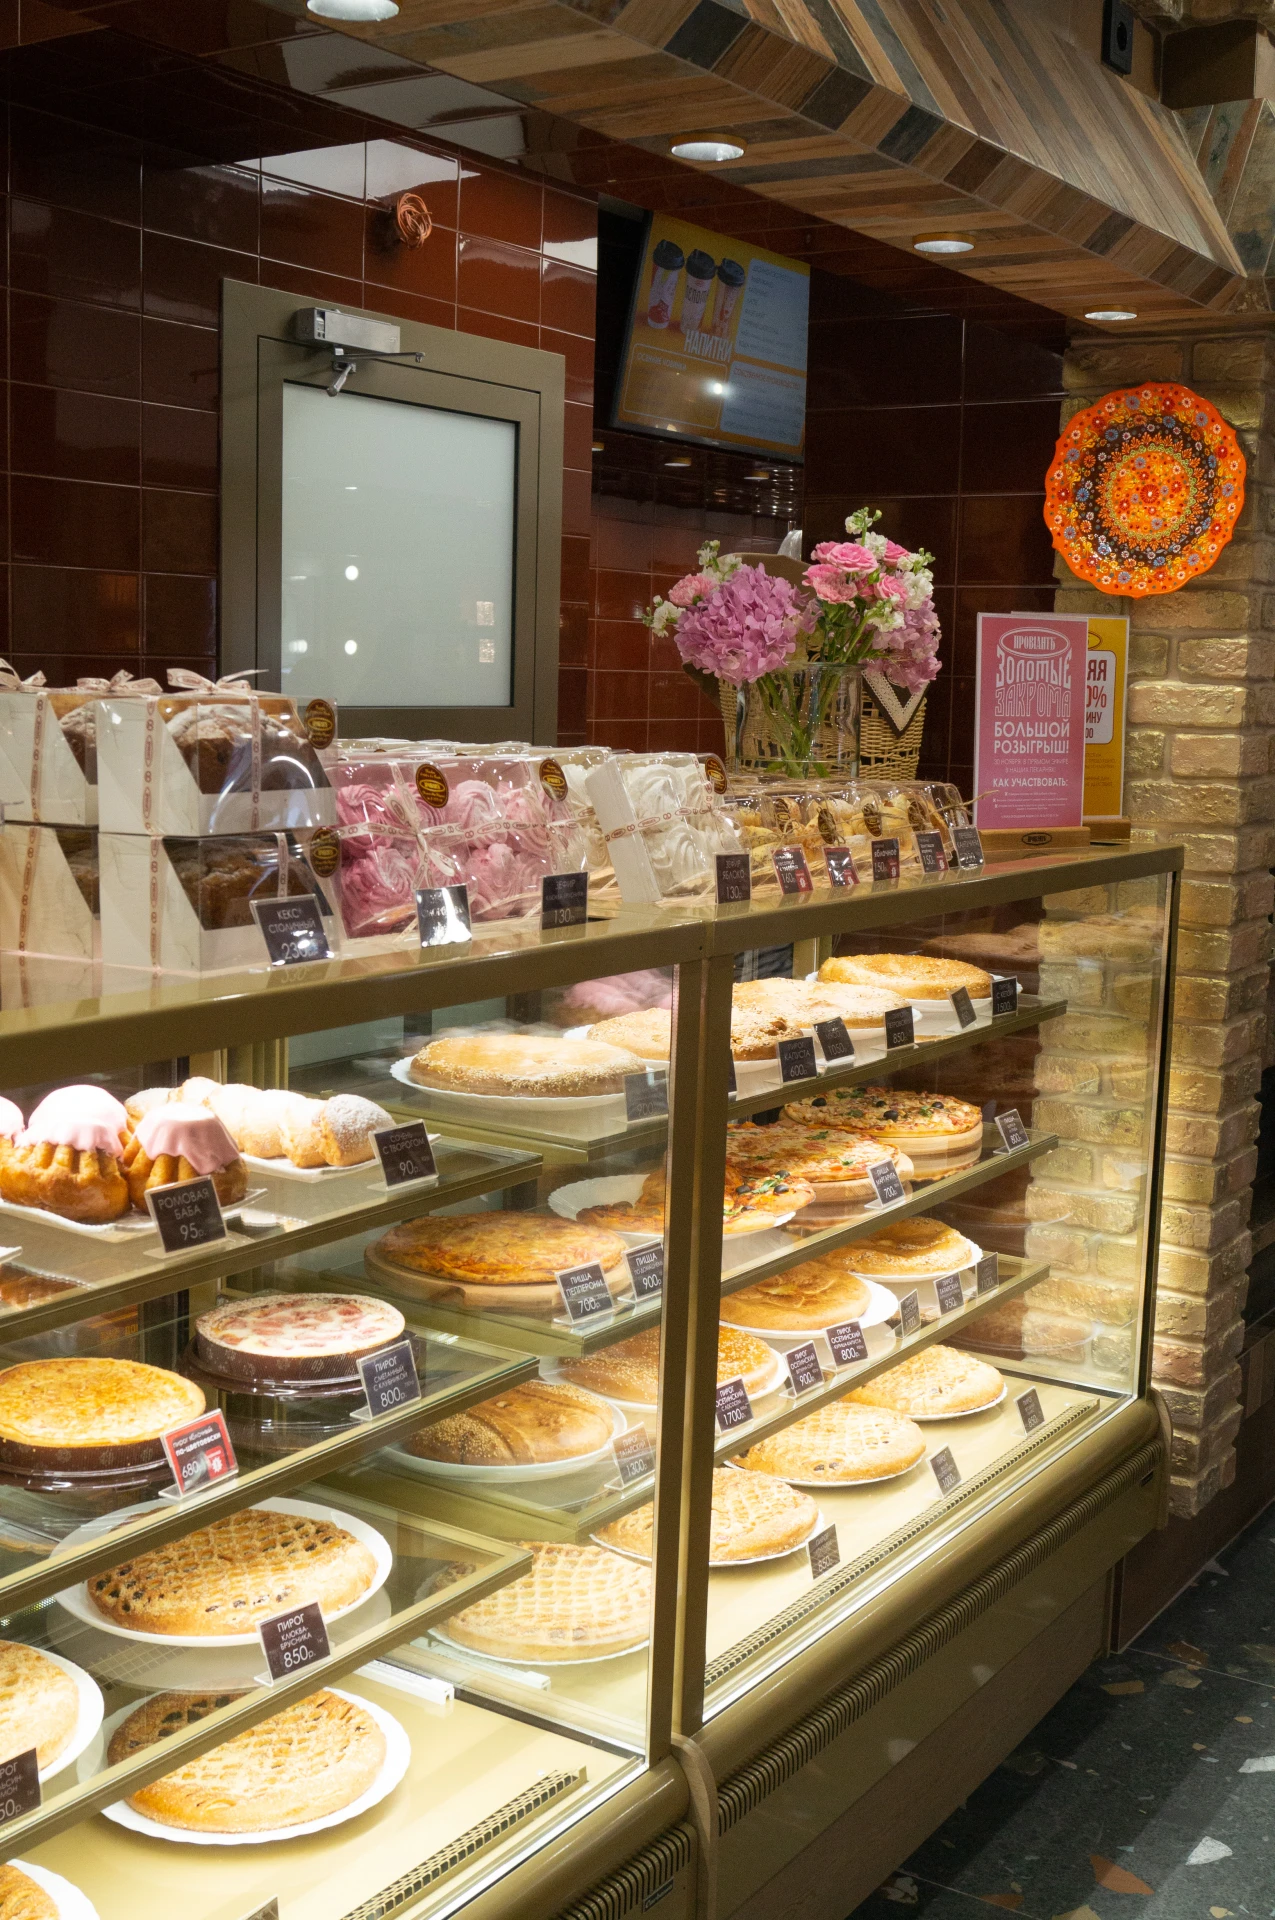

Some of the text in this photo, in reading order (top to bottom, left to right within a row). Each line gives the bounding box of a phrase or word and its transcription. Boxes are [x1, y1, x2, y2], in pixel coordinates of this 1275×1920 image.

[684, 329, 733, 362] НАПИТКИ
[995, 682, 1071, 718] ЗАКРОМА
[994, 718, 1070, 738] БОЛЬШОЙ
[994, 739, 1069, 754] РОЗЫГРЫШ!
[993, 777, 1068, 787] КАК УЧАСТВОВАТЬ:
[722, 869, 745, 881] ЯБЛОКО
[555, 879, 576, 890] ЗЕФИР
[277, 908, 300, 920] КЕКС
[268, 918, 316, 933] СТОЛИЧНЫЙ
[382, 1138, 426, 1155] С ТВОРОГОМ
[158, 1188, 210, 1210] РОМОВАЯ
[174, 1204, 202, 1220] БАБА
[635, 1252, 658, 1267] ПИЦЦА
[570, 1272, 593, 1285] ПИЦЦА
[566, 1279, 605, 1297] ПЕППЕРОНИ
[831, 1330, 861, 1344] ОСЕТИНСКИЙ
[836, 1326, 851, 1335] ПИРОГ
[790, 1352, 815, 1370] ОСЕТИНСКИЙ
[794, 1349, 807, 1360] ПИРОГ
[375, 1355, 398, 1373] ПИРОГ
[373, 1364, 405, 1384] СМЕТАННЫЙ
[373, 1384, 379, 1392] С
[378, 1371, 409, 1389] КЛУБНИКОЙ
[720, 1385, 734, 1398] ПИРОГ
[175, 1432, 222, 1457] по-цветаевски
[277, 1612, 305, 1633] ПИРОГ
[280, 1632, 313, 1651] БРУСНИКА
[281, 1625, 309, 1642] КЛЮКВА-
